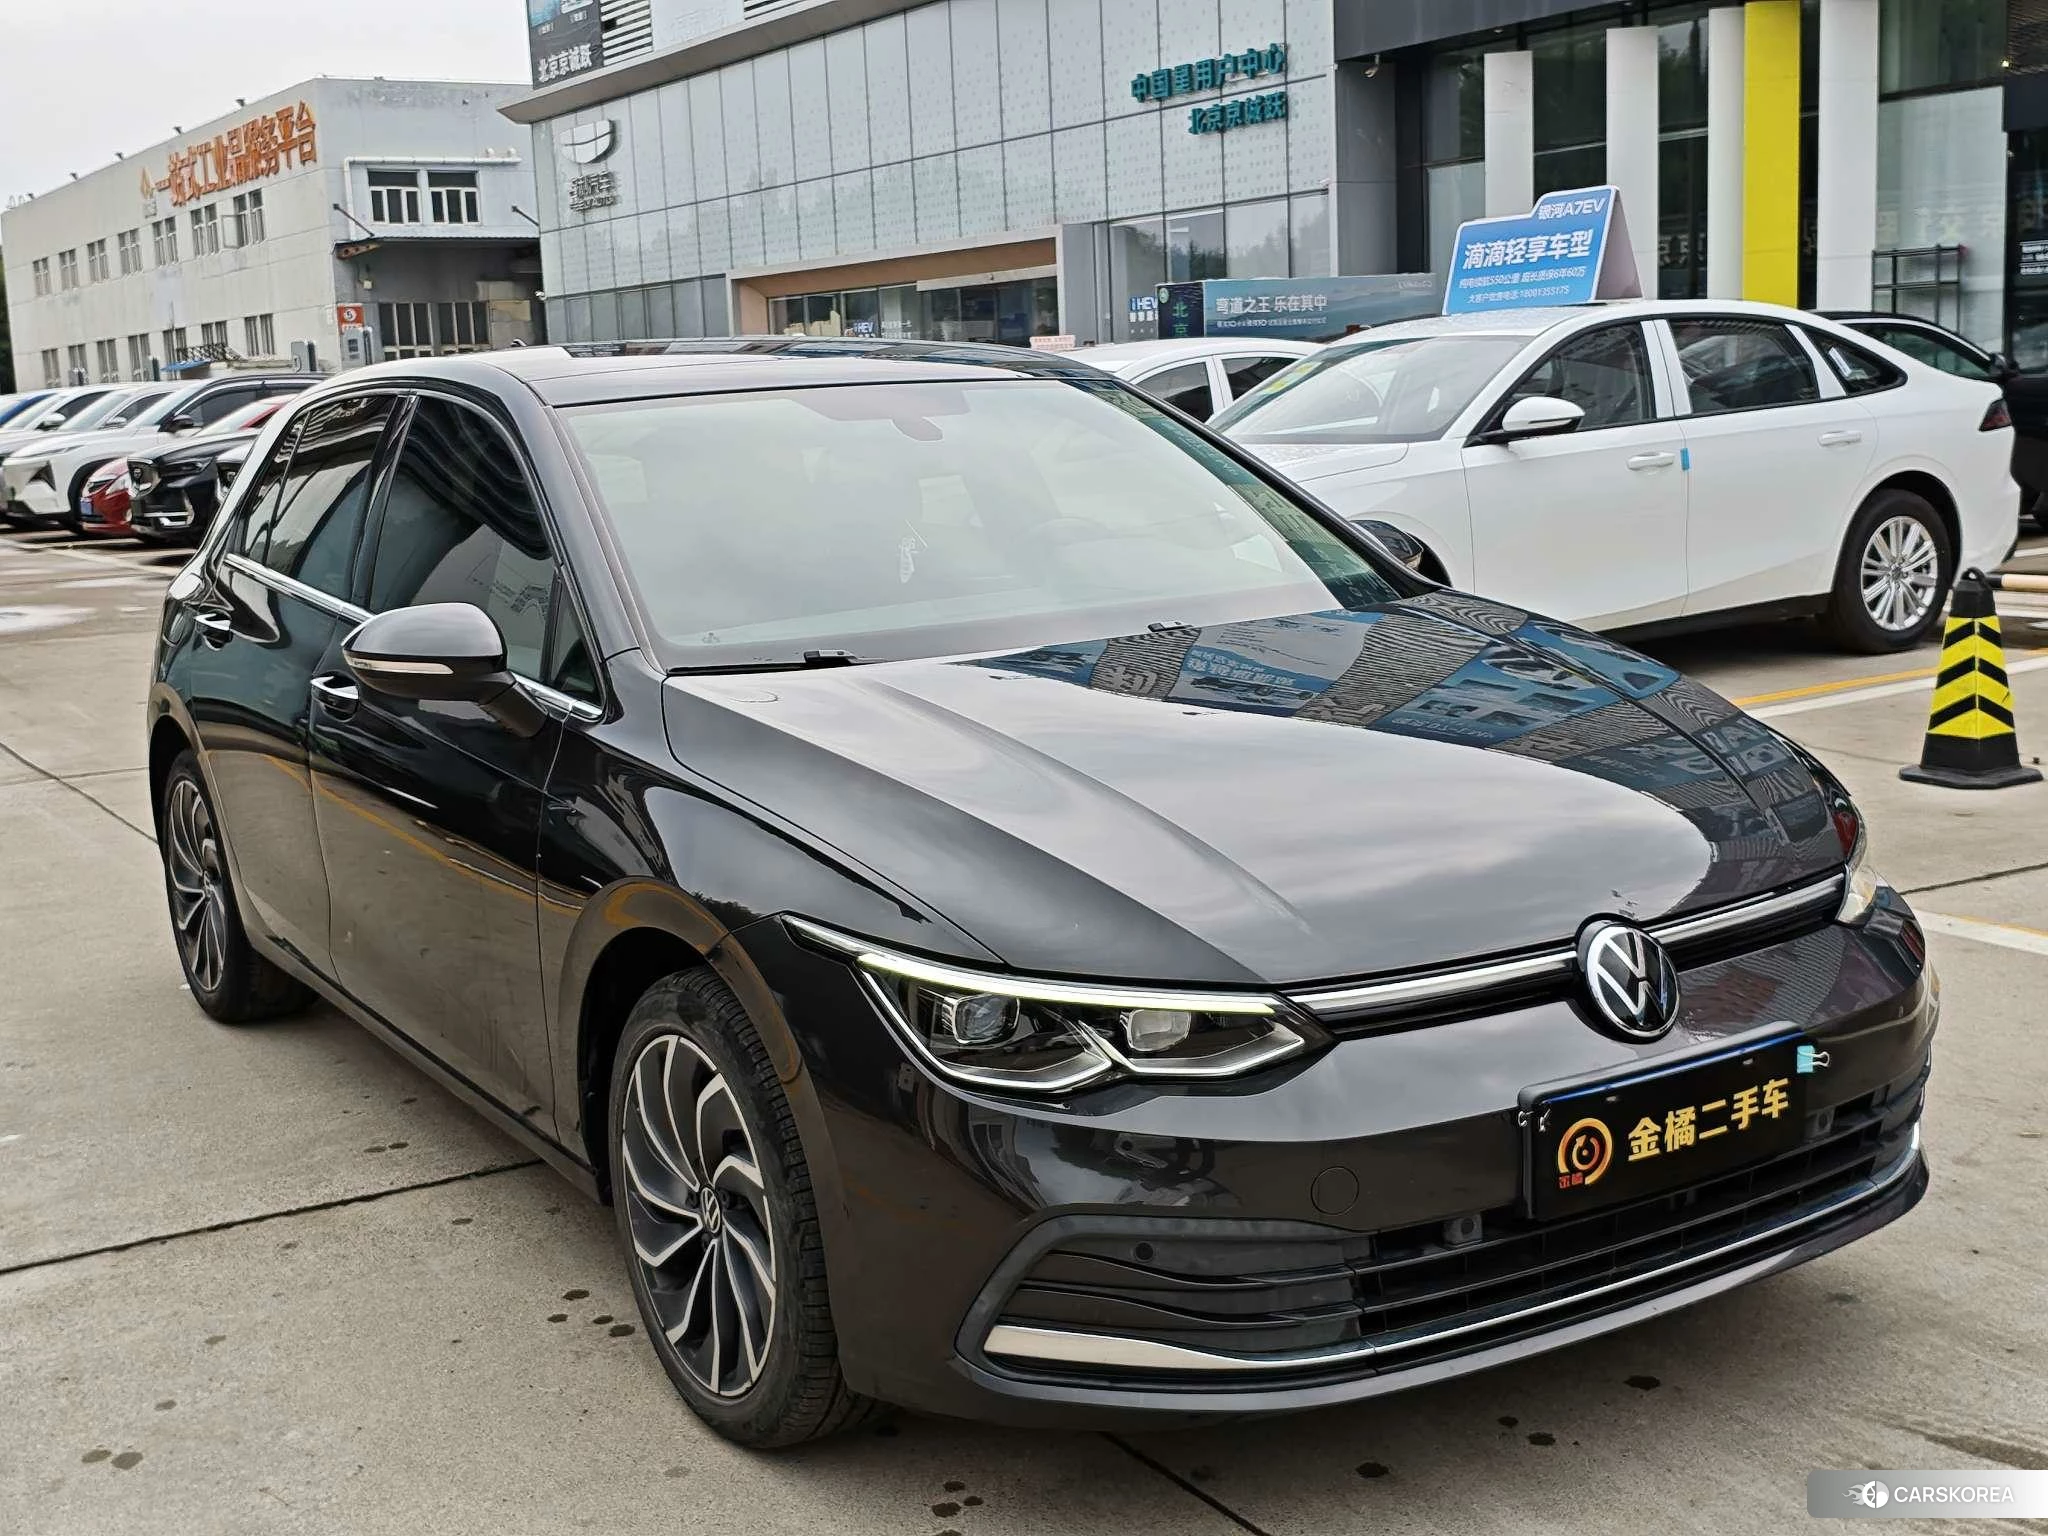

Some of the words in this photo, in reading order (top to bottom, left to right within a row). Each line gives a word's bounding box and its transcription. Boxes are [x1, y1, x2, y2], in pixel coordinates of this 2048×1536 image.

[1131, 43, 1286, 102] 中国星用户中心
[1537, 198, 1607, 220] 银河A7EV
[1462, 228, 1594, 270] 滴滴轻享车型
[1273, 294, 1328, 312] 乐在其中
[1627, 1078, 1790, 1162] 金橘二手车
